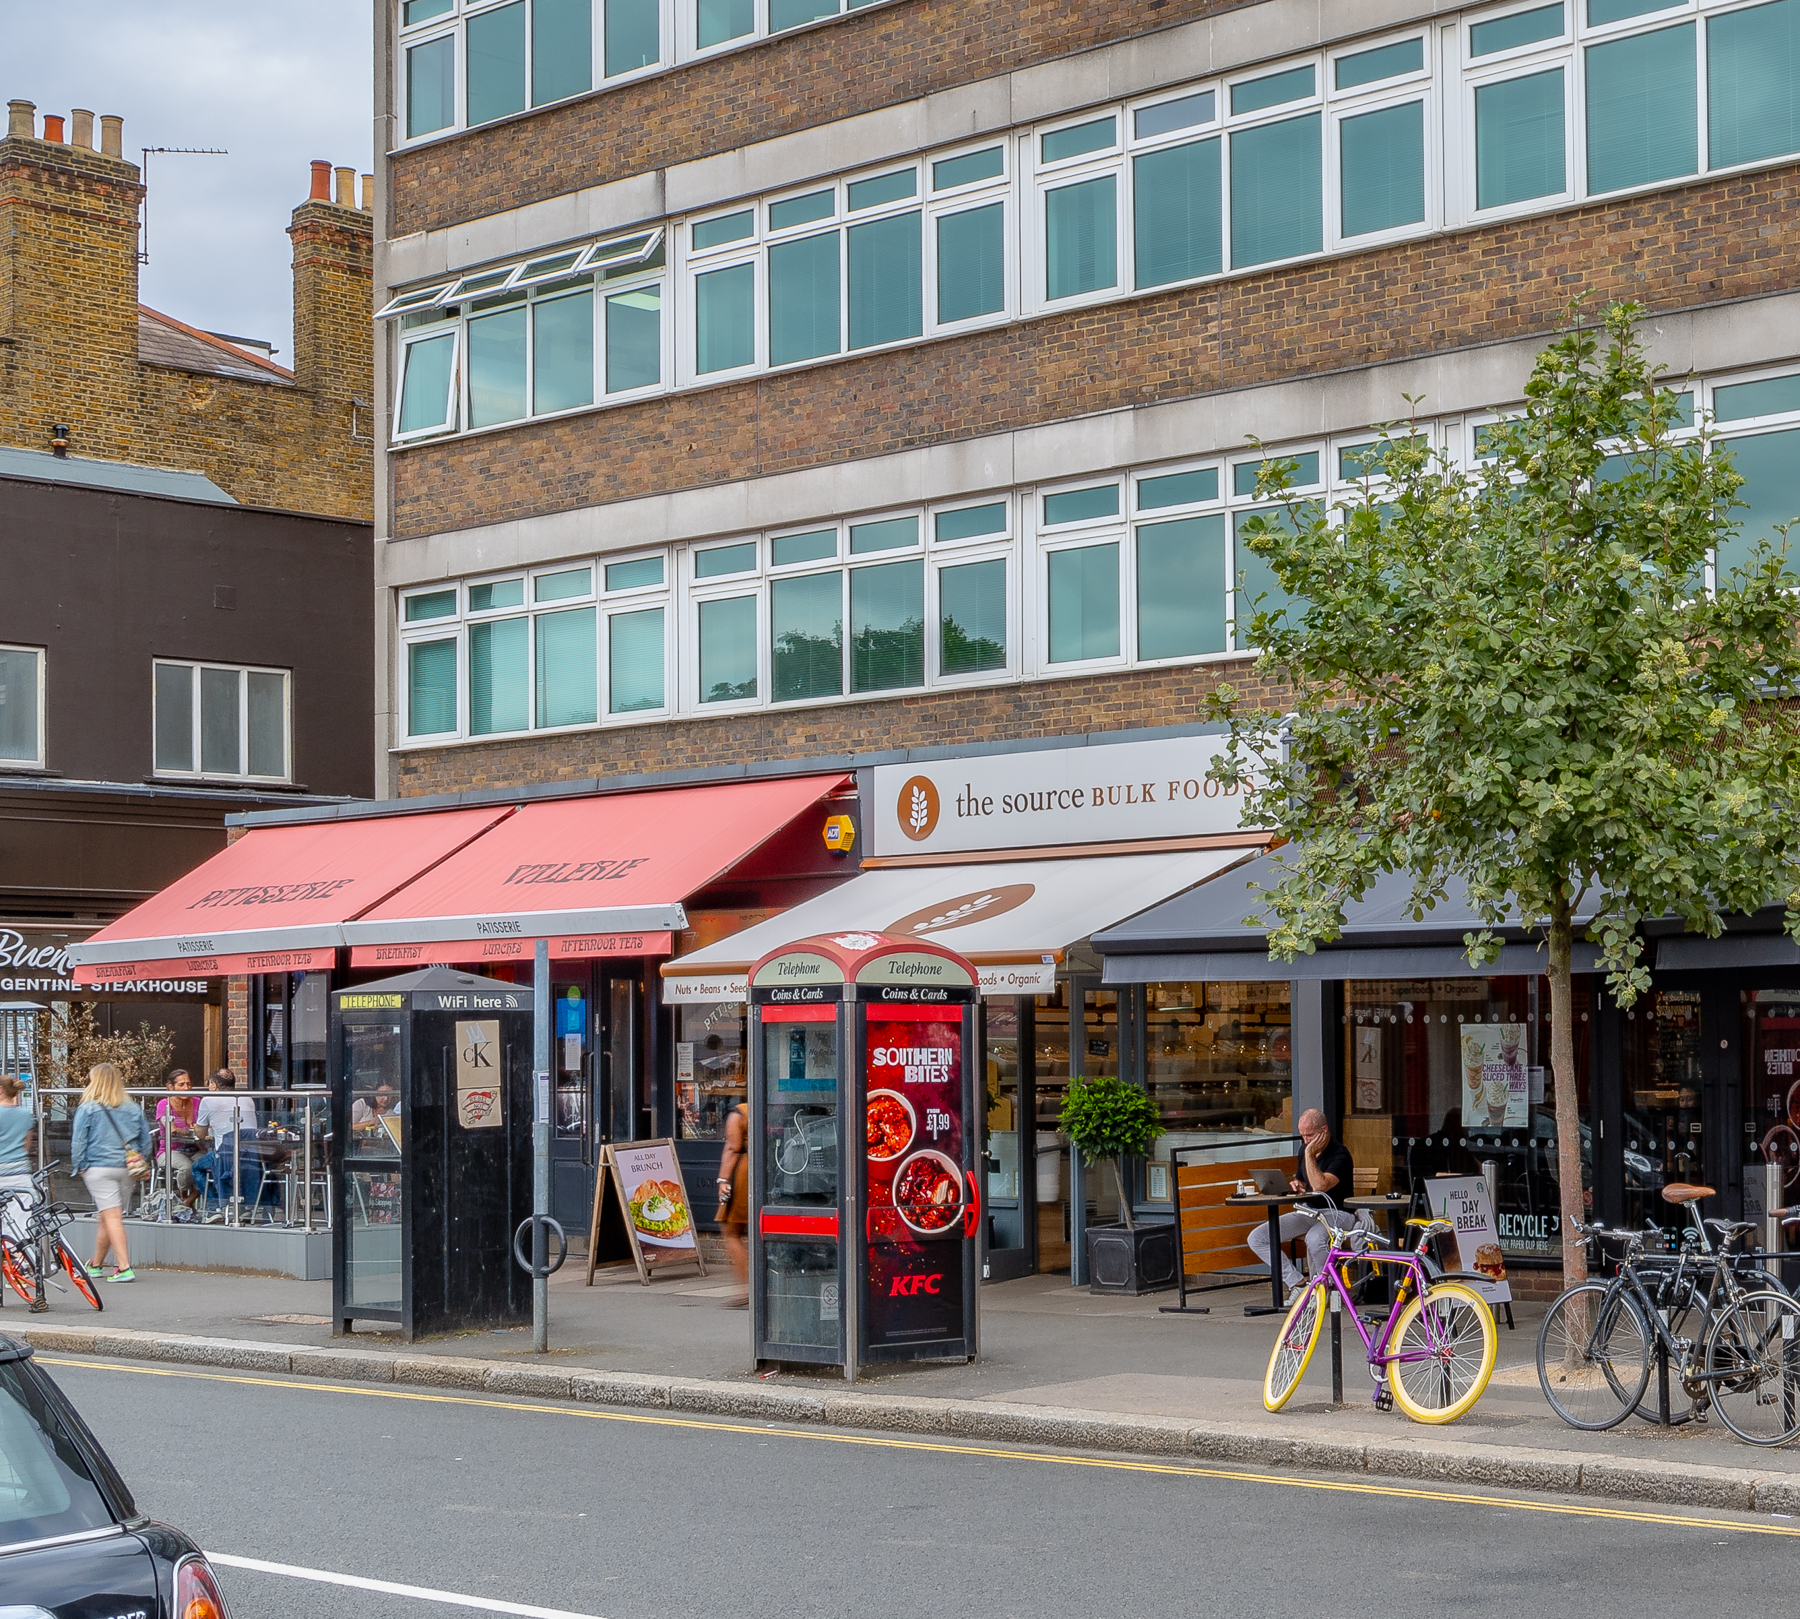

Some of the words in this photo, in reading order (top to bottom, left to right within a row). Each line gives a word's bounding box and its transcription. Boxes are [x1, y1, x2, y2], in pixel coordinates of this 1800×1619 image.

[956, 784, 994, 818] the
[1002, 786, 1085, 814] source
[1092, 783, 1156, 807] BULK
[1167, 775, 1255, 801] FOODS
[502, 858, 650, 885] VALERIE
[186, 879, 354, 909] PATISSERIE
[477, 921, 522, 934] PATISSERIE
[177, 940, 215, 953] PATISSERIE
[376, 946, 423, 960] BREAKFAST
[483, 942, 523, 956] LUNCHES
[561, 938, 616, 952] AFTERNOON
[619, 936, 643, 950] TEAS
[96, 964, 137, 978] BREAKFAST
[293, 953, 312, 965] TEAS
[777, 962, 821, 977] Telephone
[888, 961, 943, 978] Telephone
[0, 978, 82, 991] GENTINE
[91, 979, 208, 993] STEAKHOUSE
[977, 972, 997, 985] oods
[1008, 972, 1041, 988] Organic
[675, 984, 692, 995] Nuts
[700, 983, 721, 994] Beans
[771, 989, 792, 1001] Coins
[801, 988, 823, 1000] Cards
[882, 987, 907, 1000] Coins
[909, 988, 919, 1000] &
[920, 987, 948, 1001] Cards
[1444, 982, 1478, 996] Organic
[347, 995, 396, 1008] TELEPHONE
[438, 995, 468, 1008] WiFi
[474, 996, 502, 1008] here
[872, 1047, 953, 1066] SOUTHERN
[905, 1065, 949, 1083] BITES
[1483, 1064, 1523, 1073] CHEESECAKE
[1483, 1073, 1505, 1082] SLICED
[1506, 1072, 1527, 1081] THREE
[1509, 1082, 1527, 1090] WAYS
[926, 1113, 950, 1141] £1.99
[645, 1152, 657, 1160] DAY
[630, 1162, 664, 1173] BRUNCH
[1450, 1190, 1469, 1200] HELLO
[1462, 1200, 1480, 1214] DAY
[1457, 1214, 1487, 1230] BREAK
[1500, 1214, 1548, 1238] RECYCLE
[1511, 1239, 1524, 1250] PAPER
[1525, 1240, 1536, 1250] CUP
[1536, 1241, 1549, 1251] HERE
[889, 1273, 942, 1297] KFC
